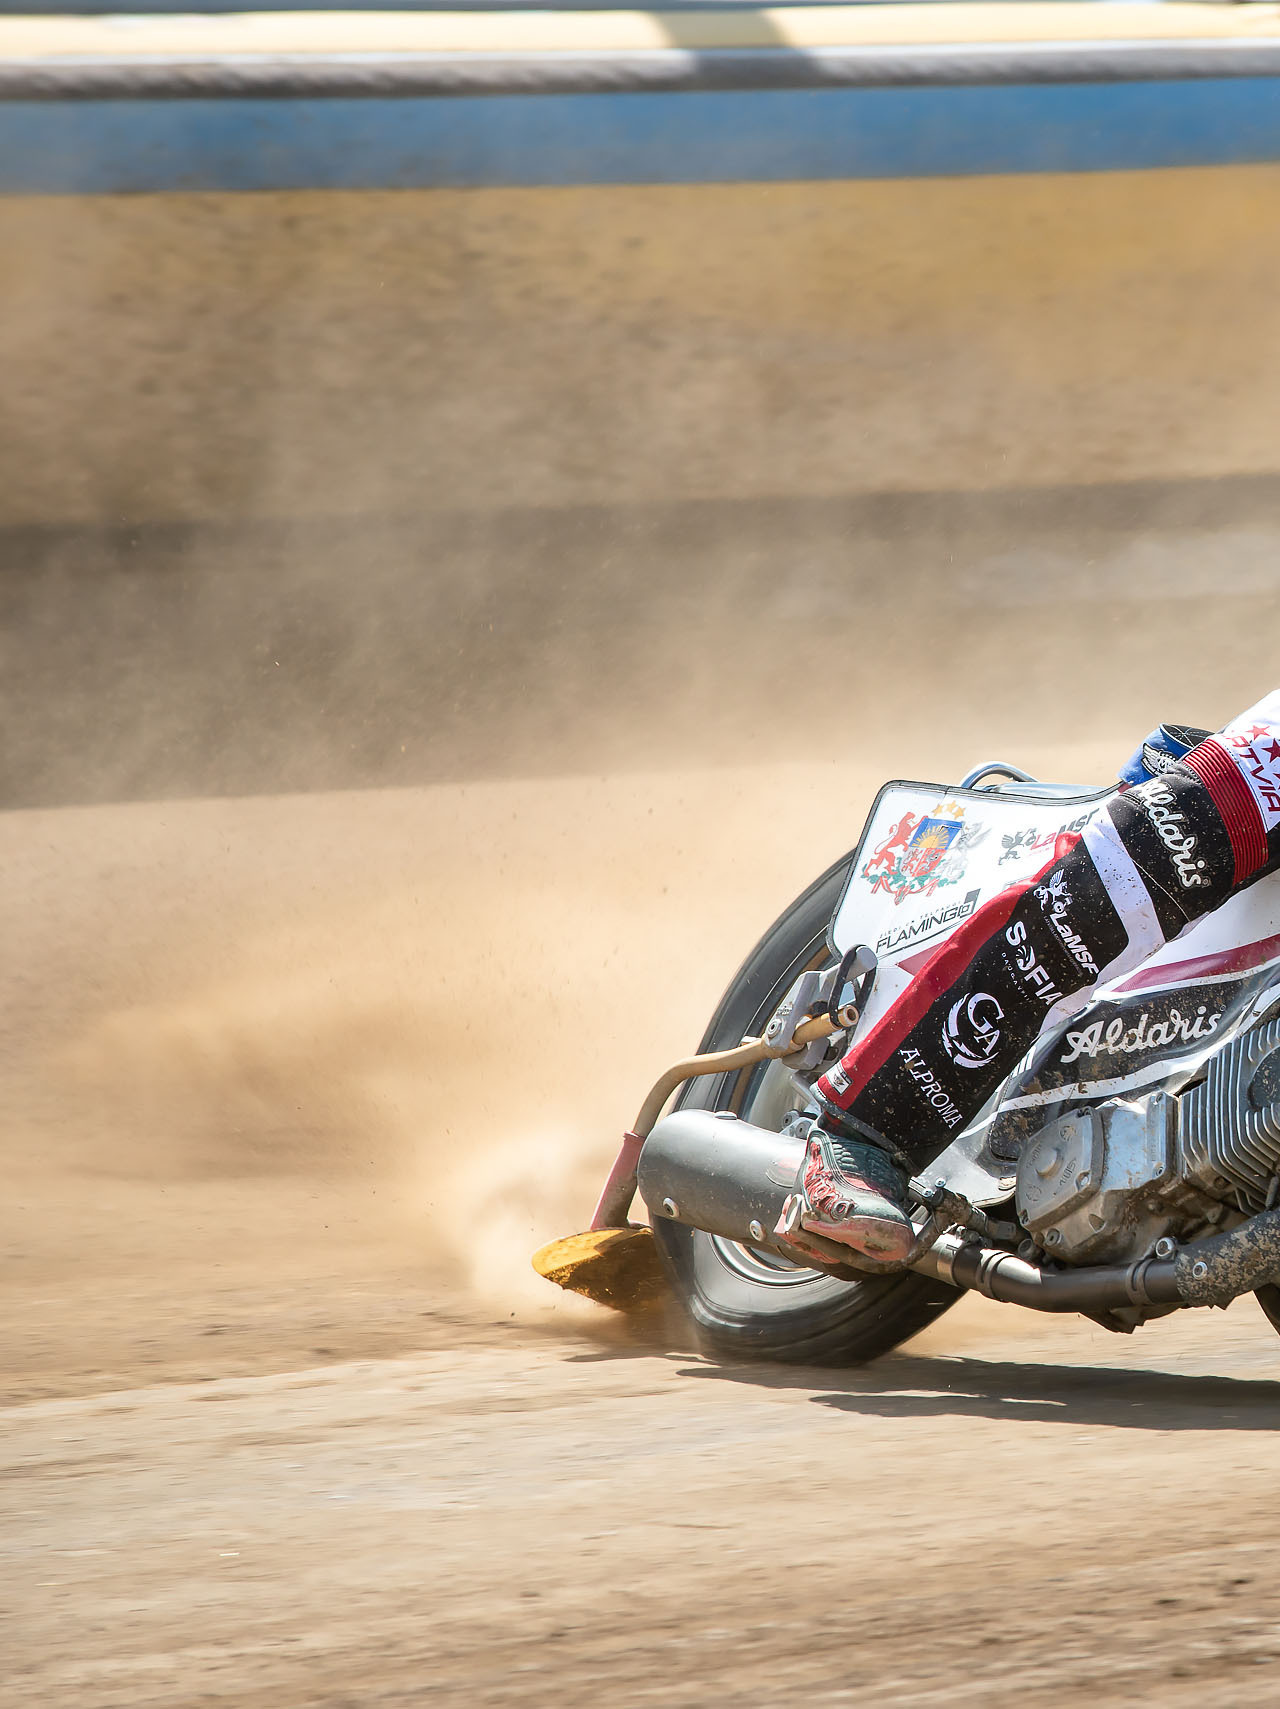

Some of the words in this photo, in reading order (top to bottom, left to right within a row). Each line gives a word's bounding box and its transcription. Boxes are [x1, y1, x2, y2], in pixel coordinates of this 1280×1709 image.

[876, 900, 975, 954] FLAMINGO
[1060, 1005, 1222, 1063] Aldaris
[900, 1048, 963, 1129] ALPROMA
